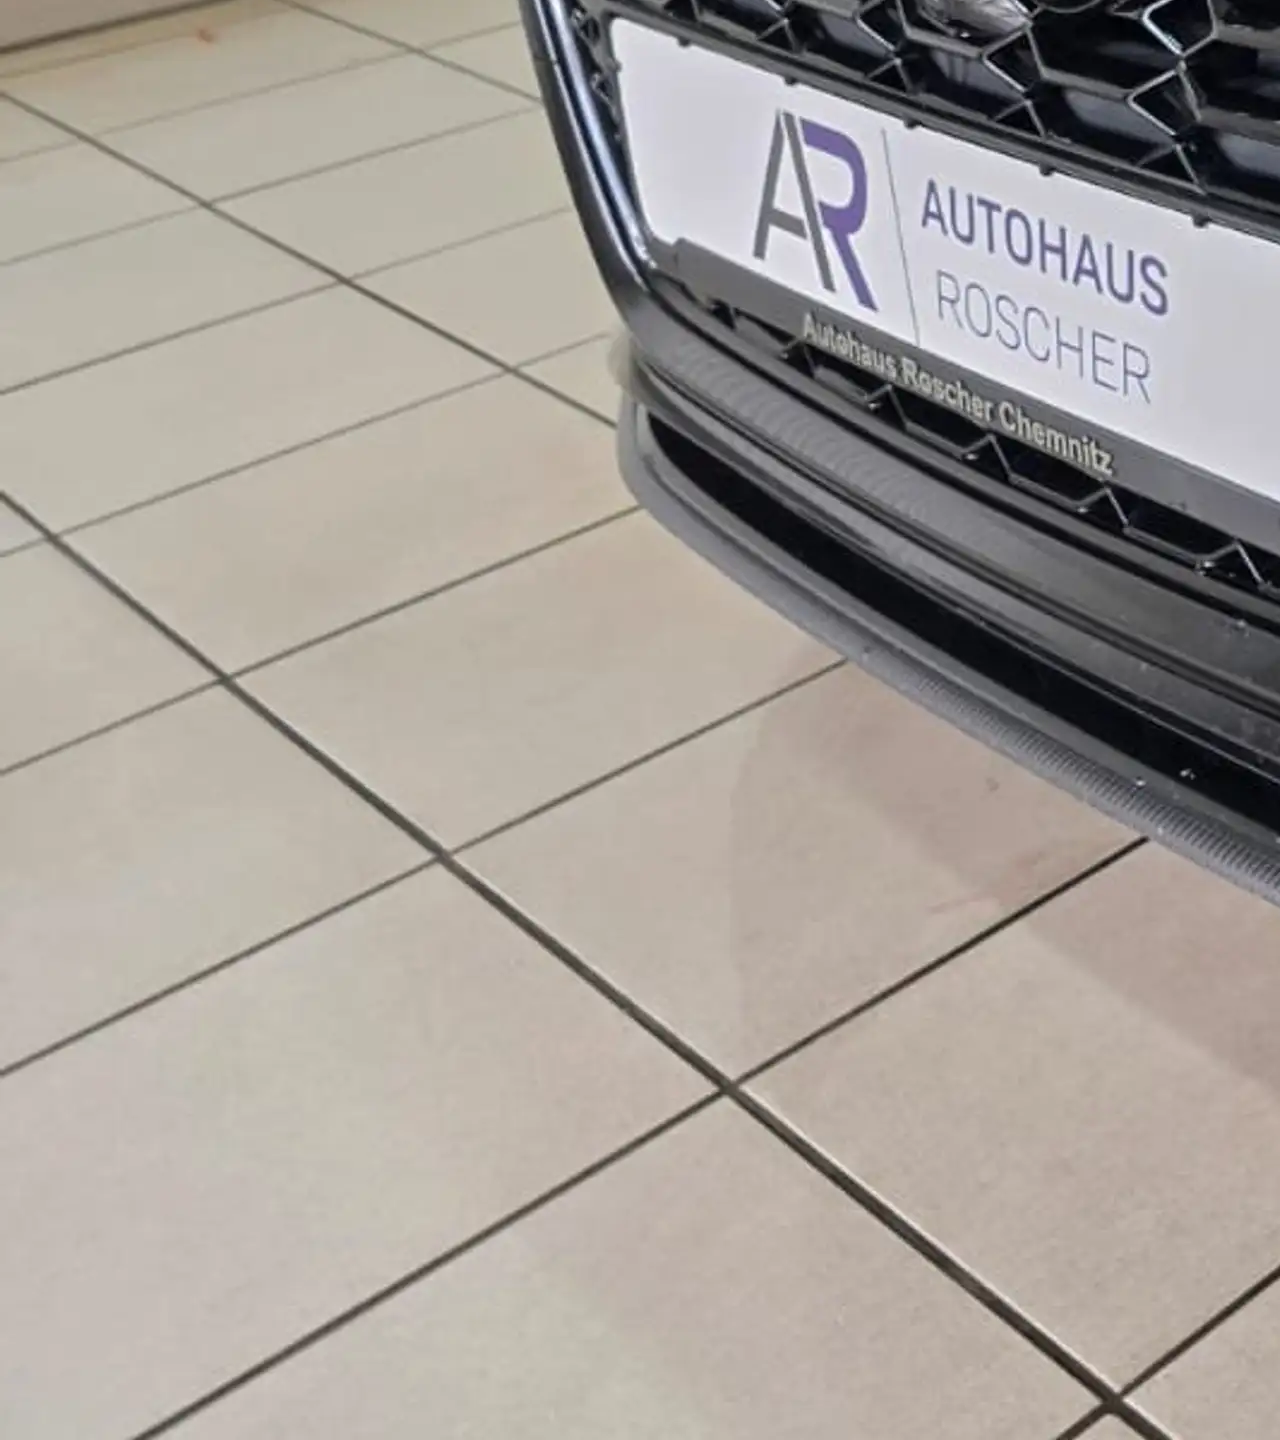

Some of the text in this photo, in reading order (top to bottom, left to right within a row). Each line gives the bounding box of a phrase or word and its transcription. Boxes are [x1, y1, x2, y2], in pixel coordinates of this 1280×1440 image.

[753, 109, 878, 312] AR
[921, 179, 1169, 317] AUTOHAUS
[803, 313, 1114, 476] Autohaus Roscher Chemnitz
[937, 270, 1152, 404] ROSCHER
